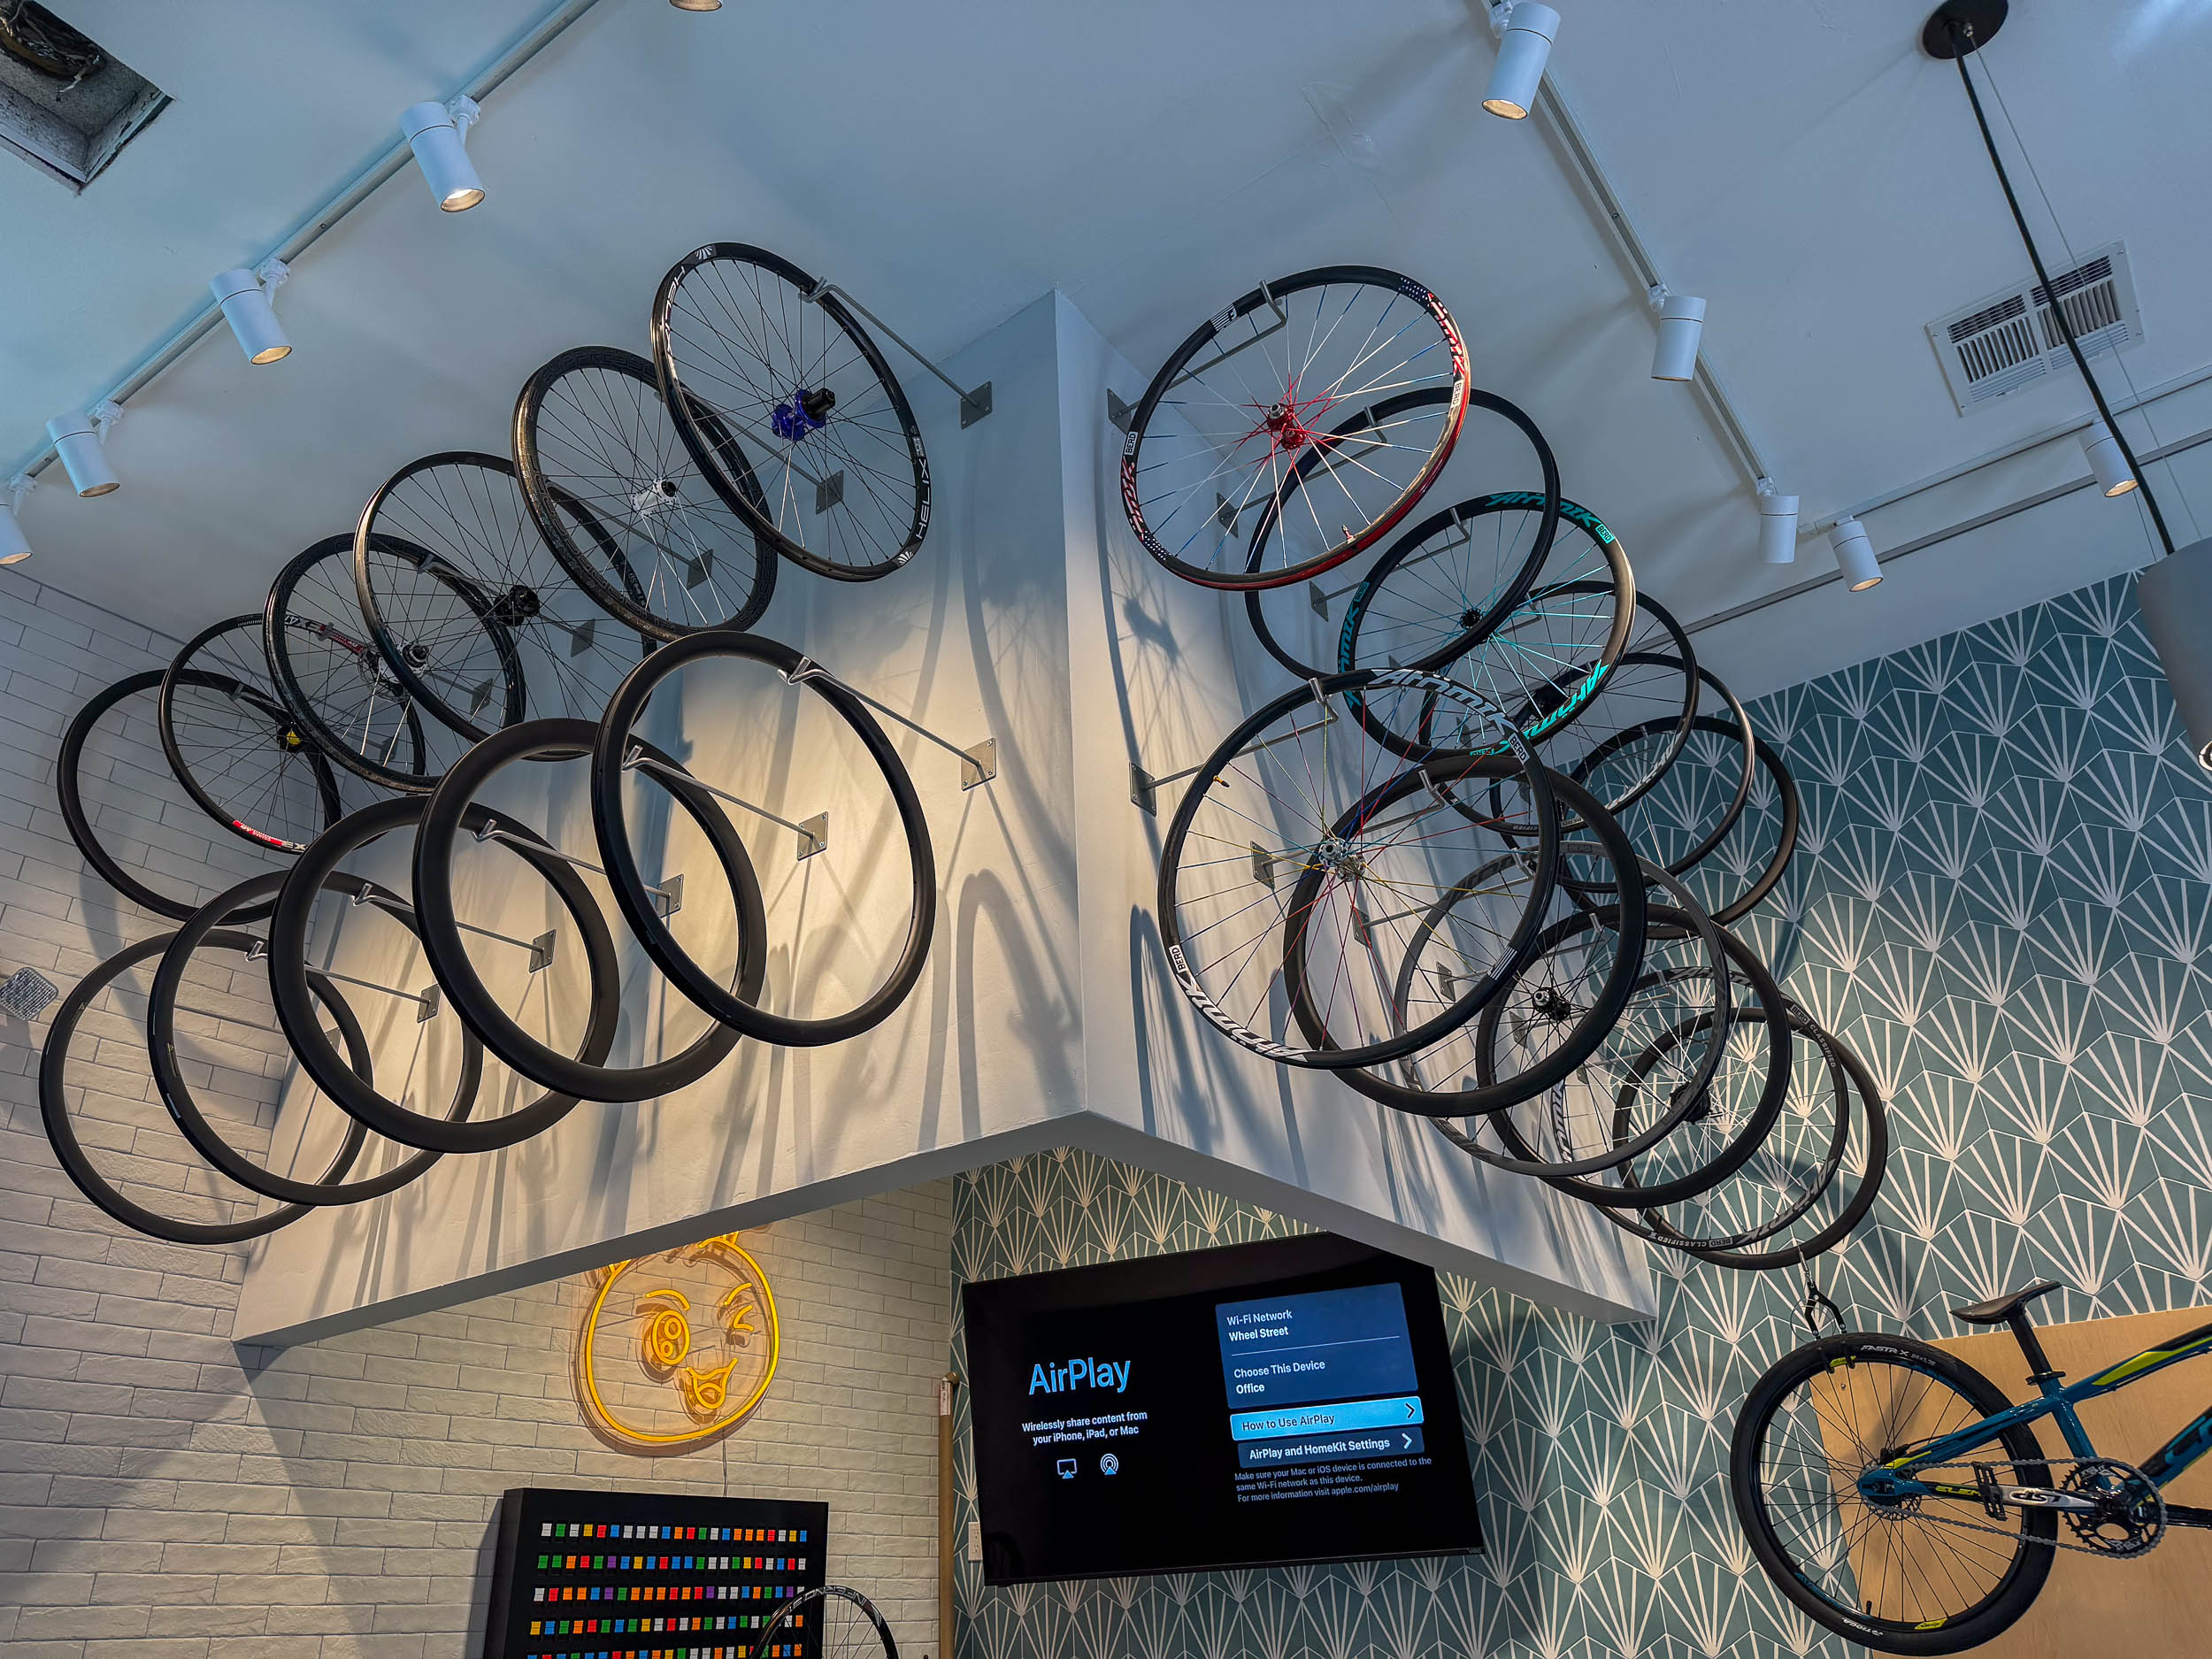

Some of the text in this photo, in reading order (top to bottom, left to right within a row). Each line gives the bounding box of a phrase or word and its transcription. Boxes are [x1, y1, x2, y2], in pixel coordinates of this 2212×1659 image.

[1452, 381, 1463, 406] BERD
[1124, 432, 1137, 455] BERD
[916, 458, 930, 539] HELIX
[1596, 524, 1614, 543] BERD
[1509, 734, 1529, 763] BERD
[252, 831, 272, 842] SWISS
[1171, 947, 1187, 972] BERD
[1791, 1004, 1837, 1069] BERD CLASSIFIED
[1656, 1235, 1732, 1248] BERD CLASSIFIED
[1226, 1309, 1293, 1326] Wi-Fi Network
[1228, 1325, 1289, 1342] Wheel Street
[1028, 1356, 1131, 1395] AirPlay
[1233, 1360, 1326, 1379] Choose This Device
[1235, 1382, 1265, 1395] Office
[1021, 1411, 1148, 1432] Wirelessly share content from
[1242, 1414, 1335, 1432] How to Use AirPlay
[1033, 1434, 1052, 1447] your
[1053, 1432, 1086, 1443] iPhone,
[1086, 1427, 1108, 1440] iPad,
[1119, 1425, 1140, 1436] Mac
[1249, 1438, 1391, 1461] AirPlay and HomeKit Settings
[1234, 1471, 1255, 1482] Make
[1256, 1471, 1271, 1480] sure
[1272, 1469, 1289, 1480] your
[1291, 1466, 1307, 1477] Mac
[1317, 1465, 1331, 1474] iOS
[1333, 1463, 1357, 1472] device
[1358, 1462, 1365, 1471] is
[1366, 1458, 1408, 1471] connected
[1409, 1457, 1417, 1467] to
[1418, 1455, 1432, 1466] the
[1236, 1482, 1256, 1492] same
[1256, 1480, 1277, 1491] Wi-Fi
[1278, 1477, 1308, 1488] network
[1319, 1475, 1334, 1485] this
[1335, 1473, 1363, 1484] device.
[1237, 1482, 1399, 1502] For more information visit apple.com/airplay
